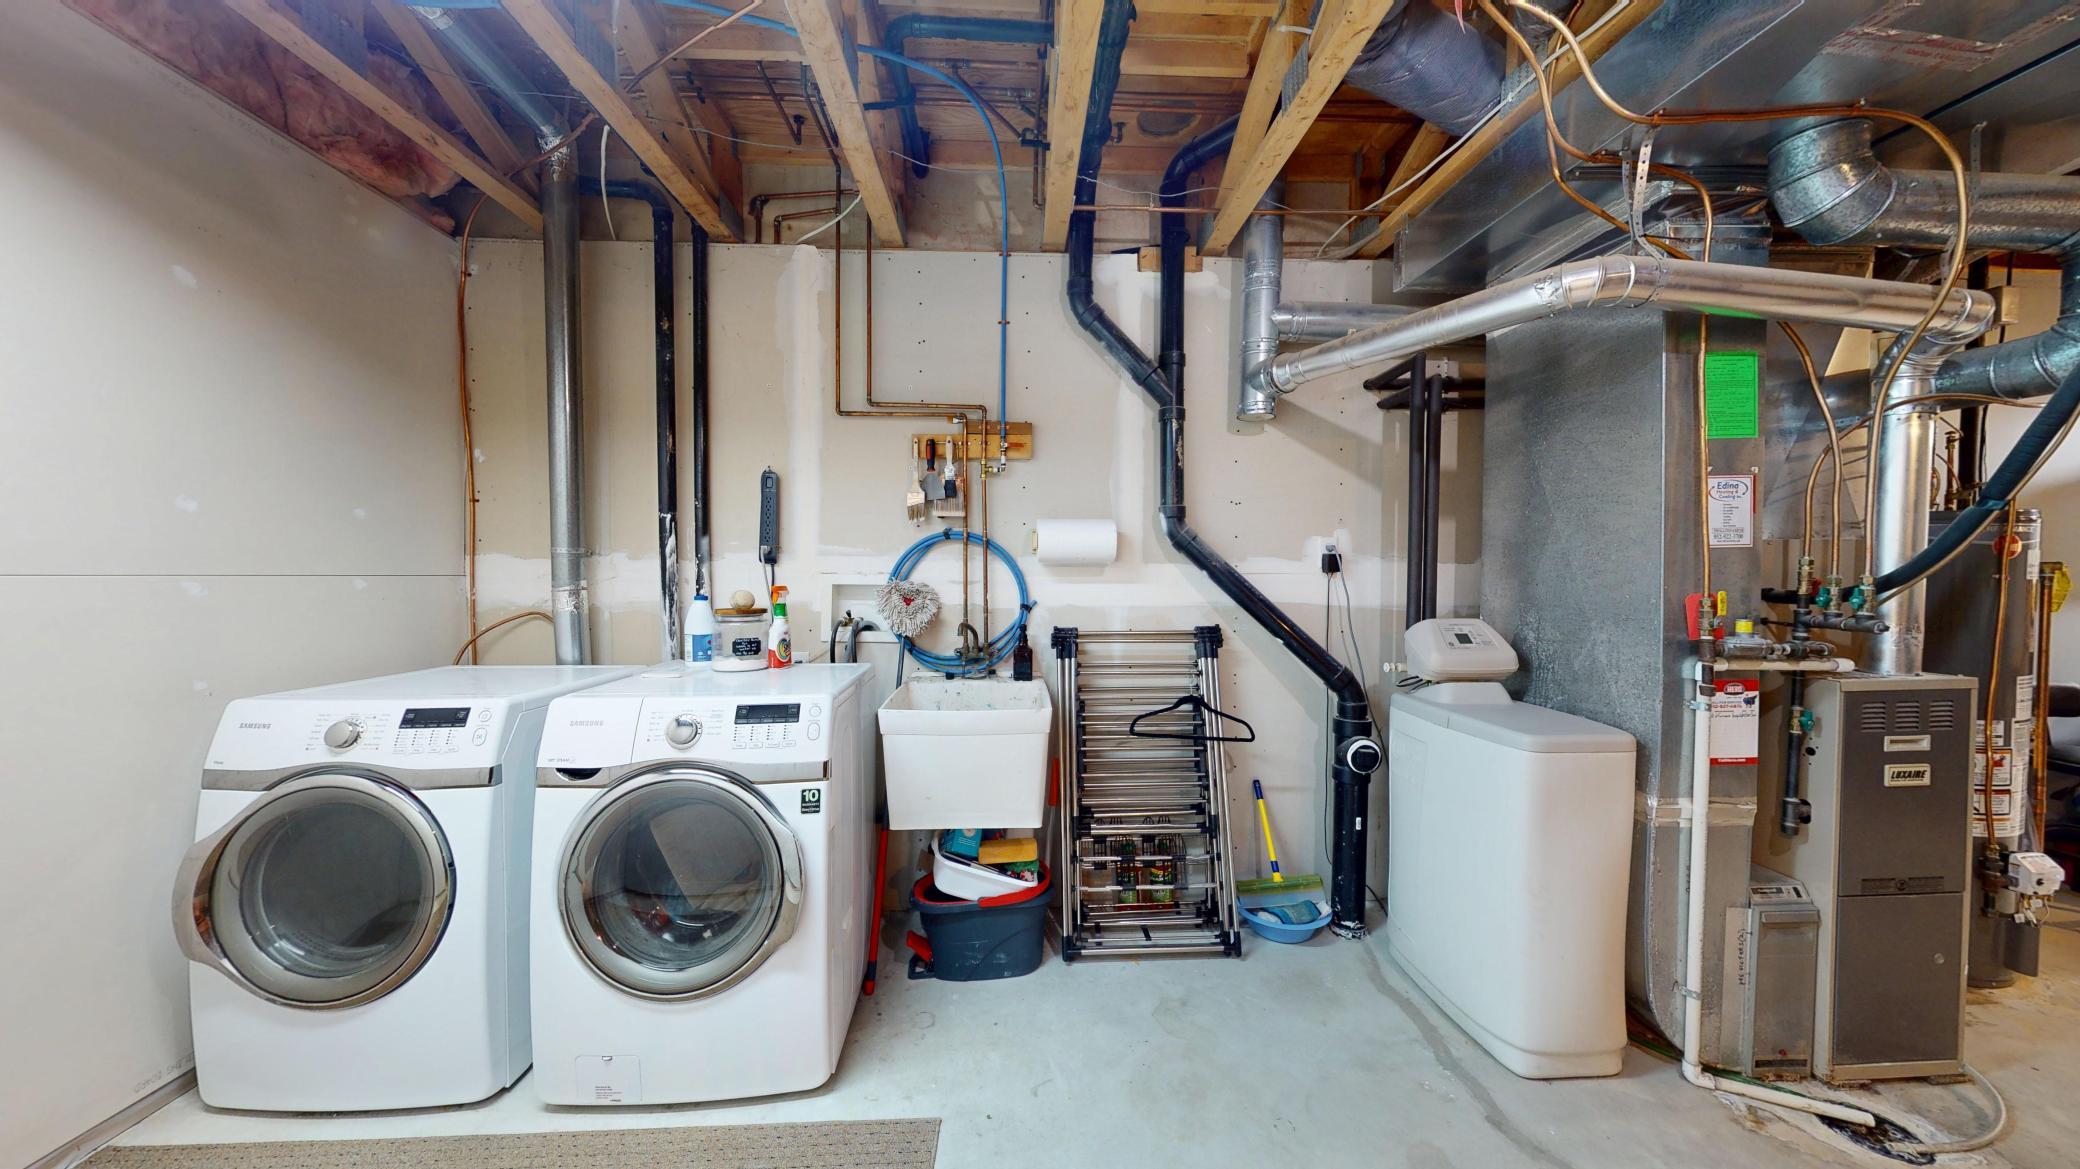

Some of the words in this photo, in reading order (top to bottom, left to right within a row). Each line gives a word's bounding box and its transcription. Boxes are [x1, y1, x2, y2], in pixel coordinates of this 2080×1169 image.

[1717, 481, 1739, 490] Edina
[1890, 770, 1928, 779] LUXAIRE
[802, 789, 819, 802] 10
